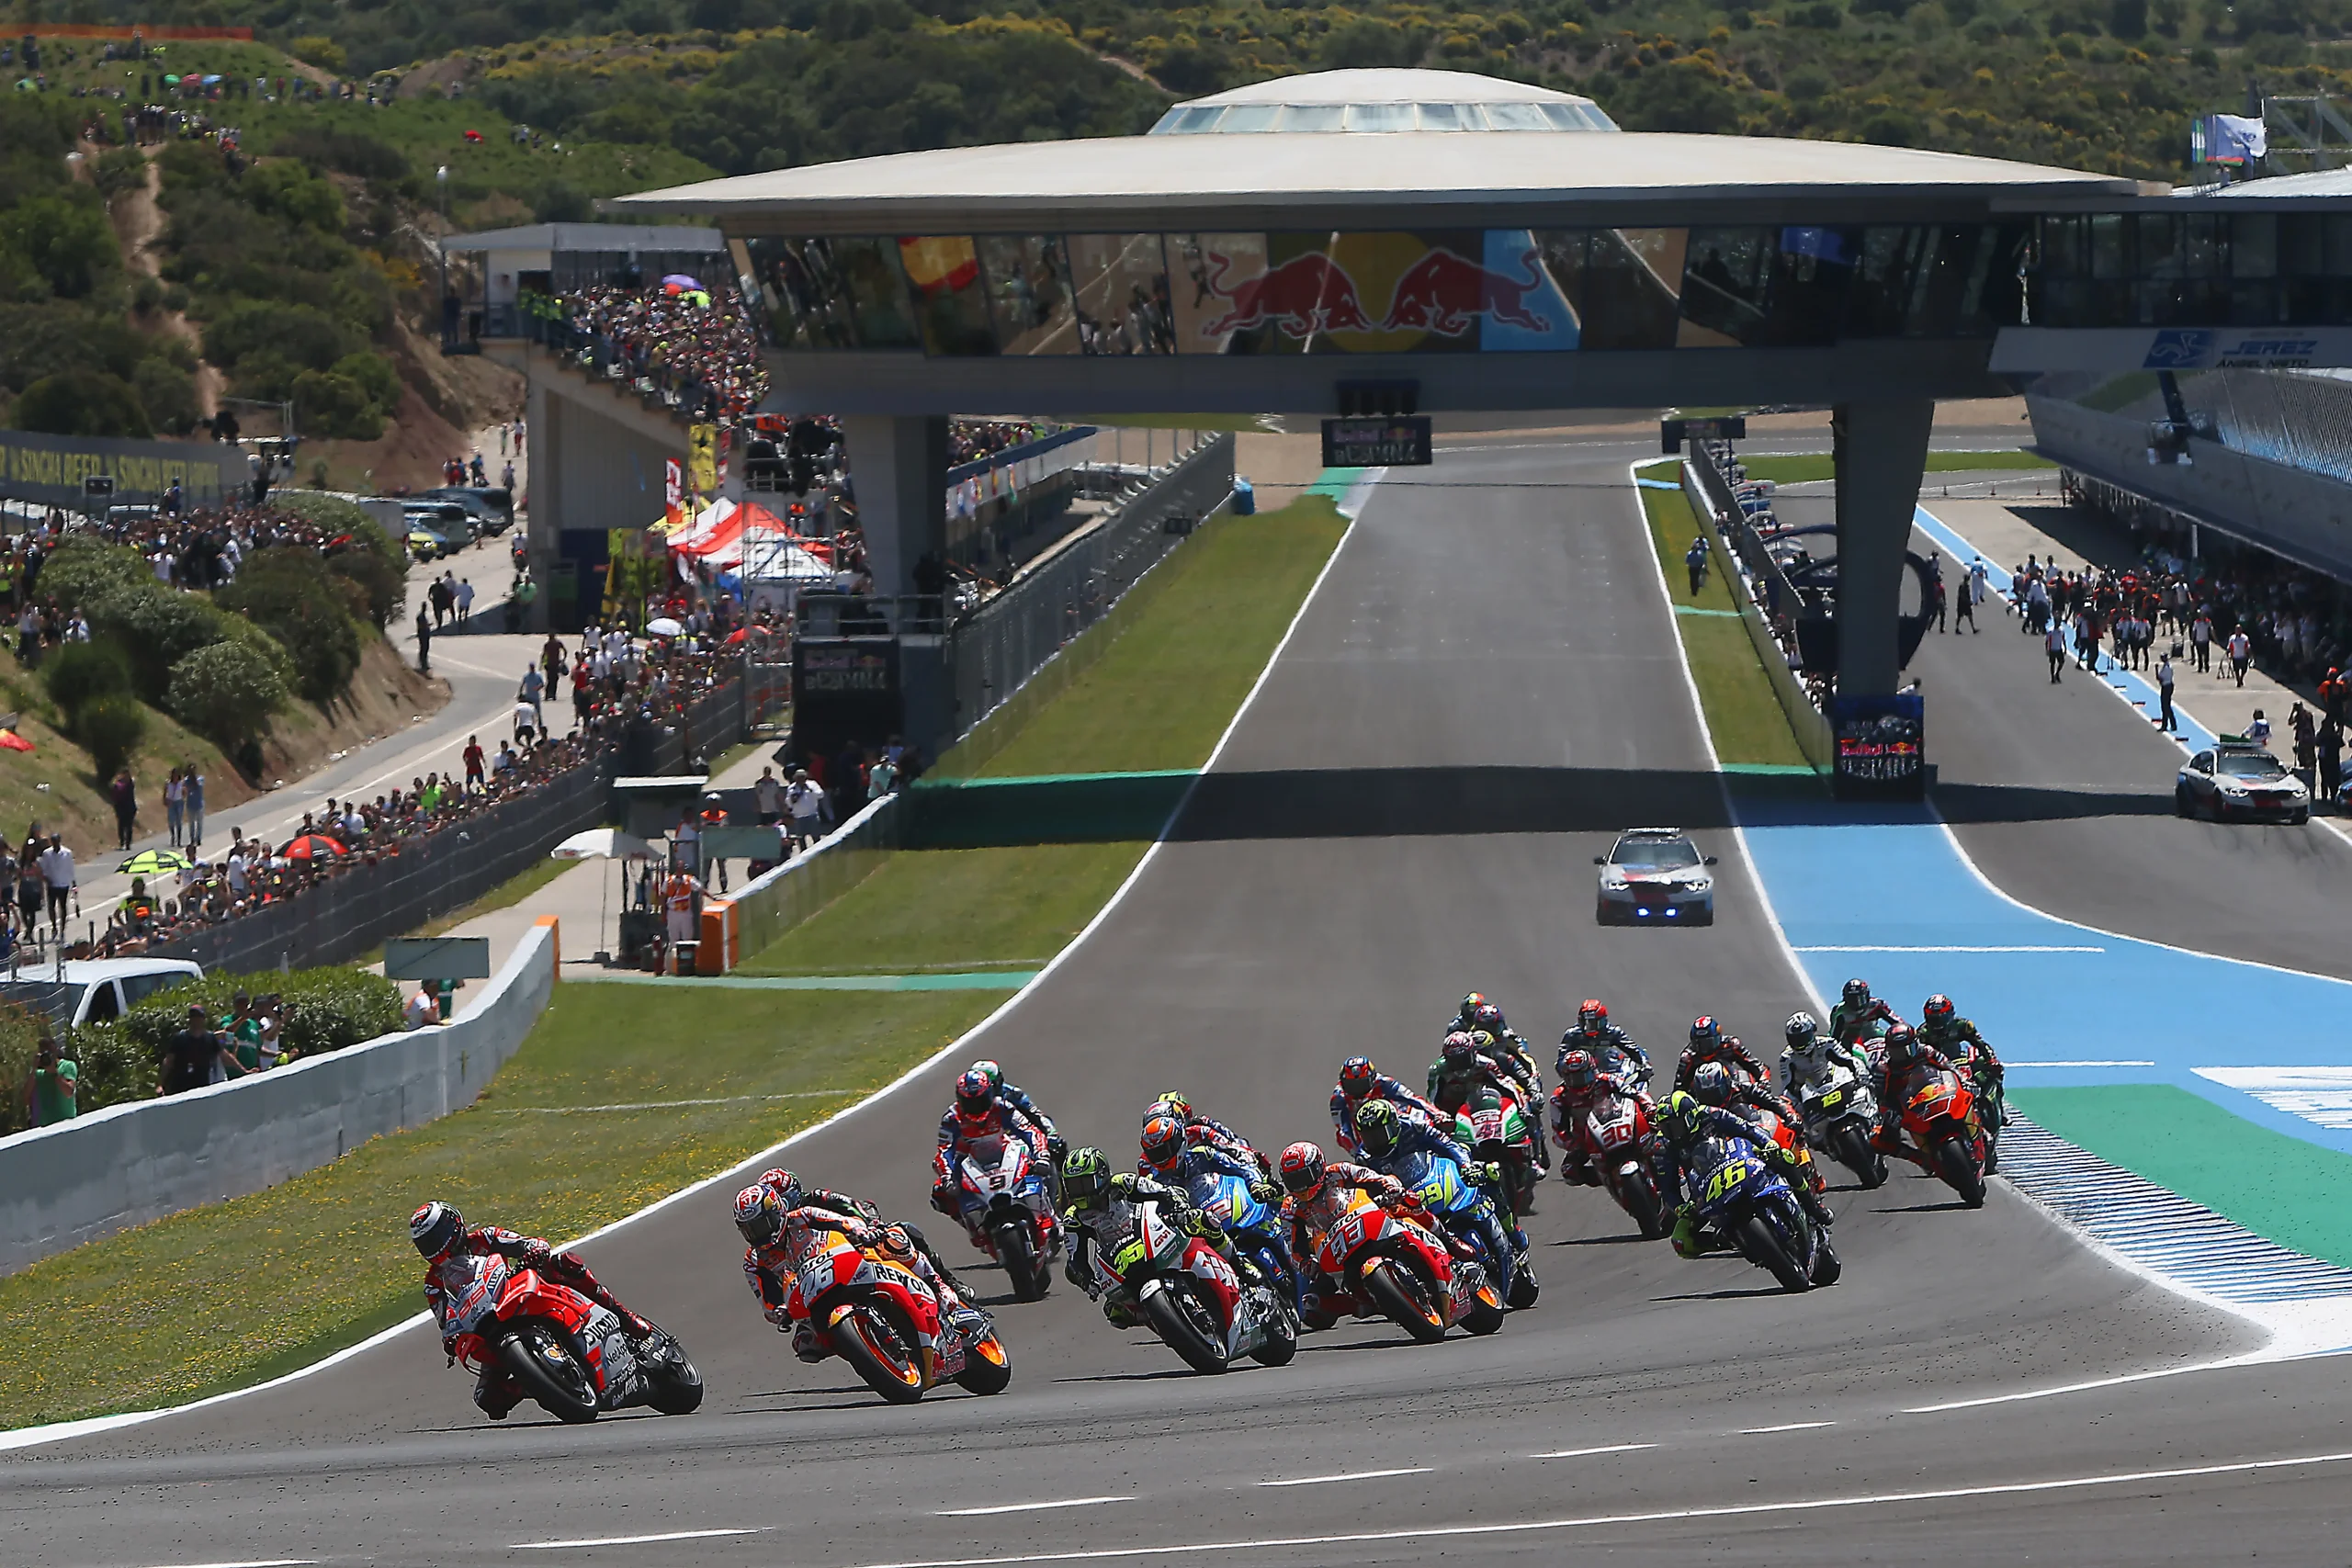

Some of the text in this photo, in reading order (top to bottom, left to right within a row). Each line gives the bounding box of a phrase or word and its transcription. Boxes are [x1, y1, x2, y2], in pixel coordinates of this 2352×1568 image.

[1821, 1090, 1842, 1108] 19
[1476, 1123, 1502, 1139] 41
[1602, 1124, 1633, 1148] 30
[989, 1175, 1005, 1190] 9
[1706, 1160, 1746, 1202] 46
[1322, 1210, 1361, 1247] REPSOL
[1330, 1218, 1365, 1265] 93
[789, 1250, 833, 1291] REPSOL
[1114, 1238, 1145, 1275] 35
[800, 1259, 834, 1308] 26
[874, 1263, 933, 1297] REPSOL
